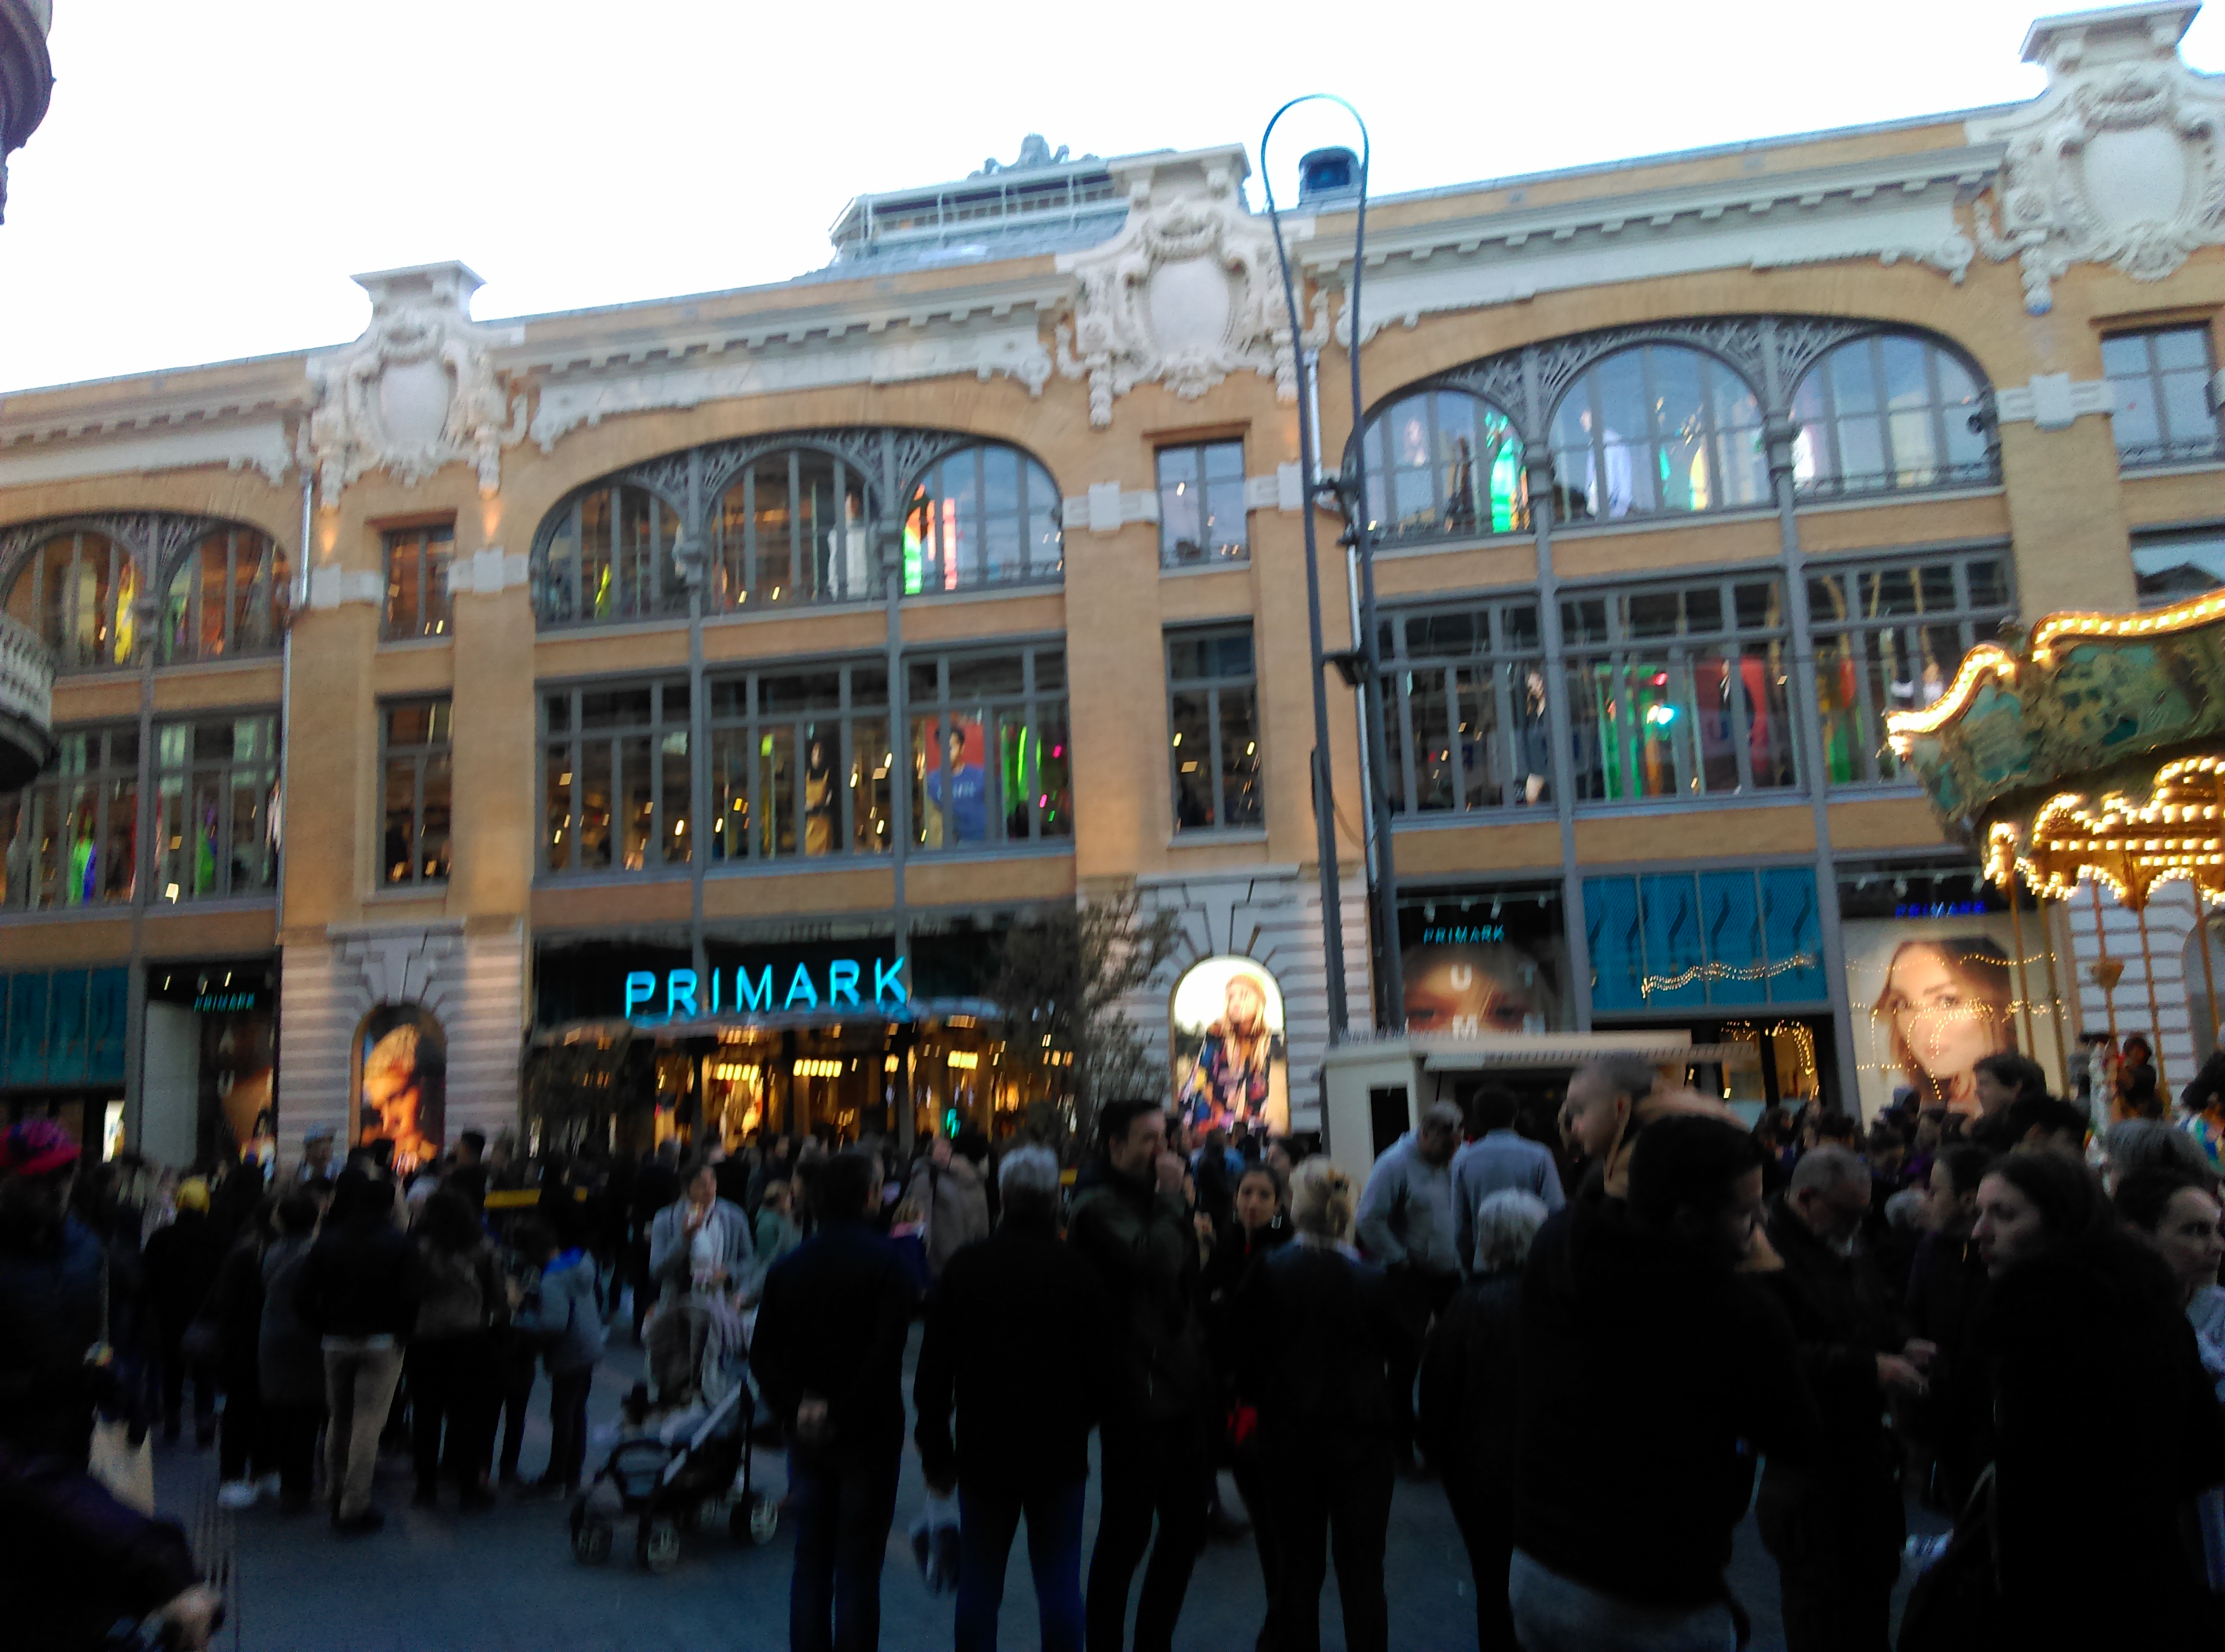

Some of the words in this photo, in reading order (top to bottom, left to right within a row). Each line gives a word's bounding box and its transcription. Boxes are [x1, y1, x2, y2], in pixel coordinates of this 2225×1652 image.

[1423, 923, 1504, 945] PRIMARK
[625, 955, 907, 1020] PRIMARK
[194, 992, 255, 1013] PRIMARK
